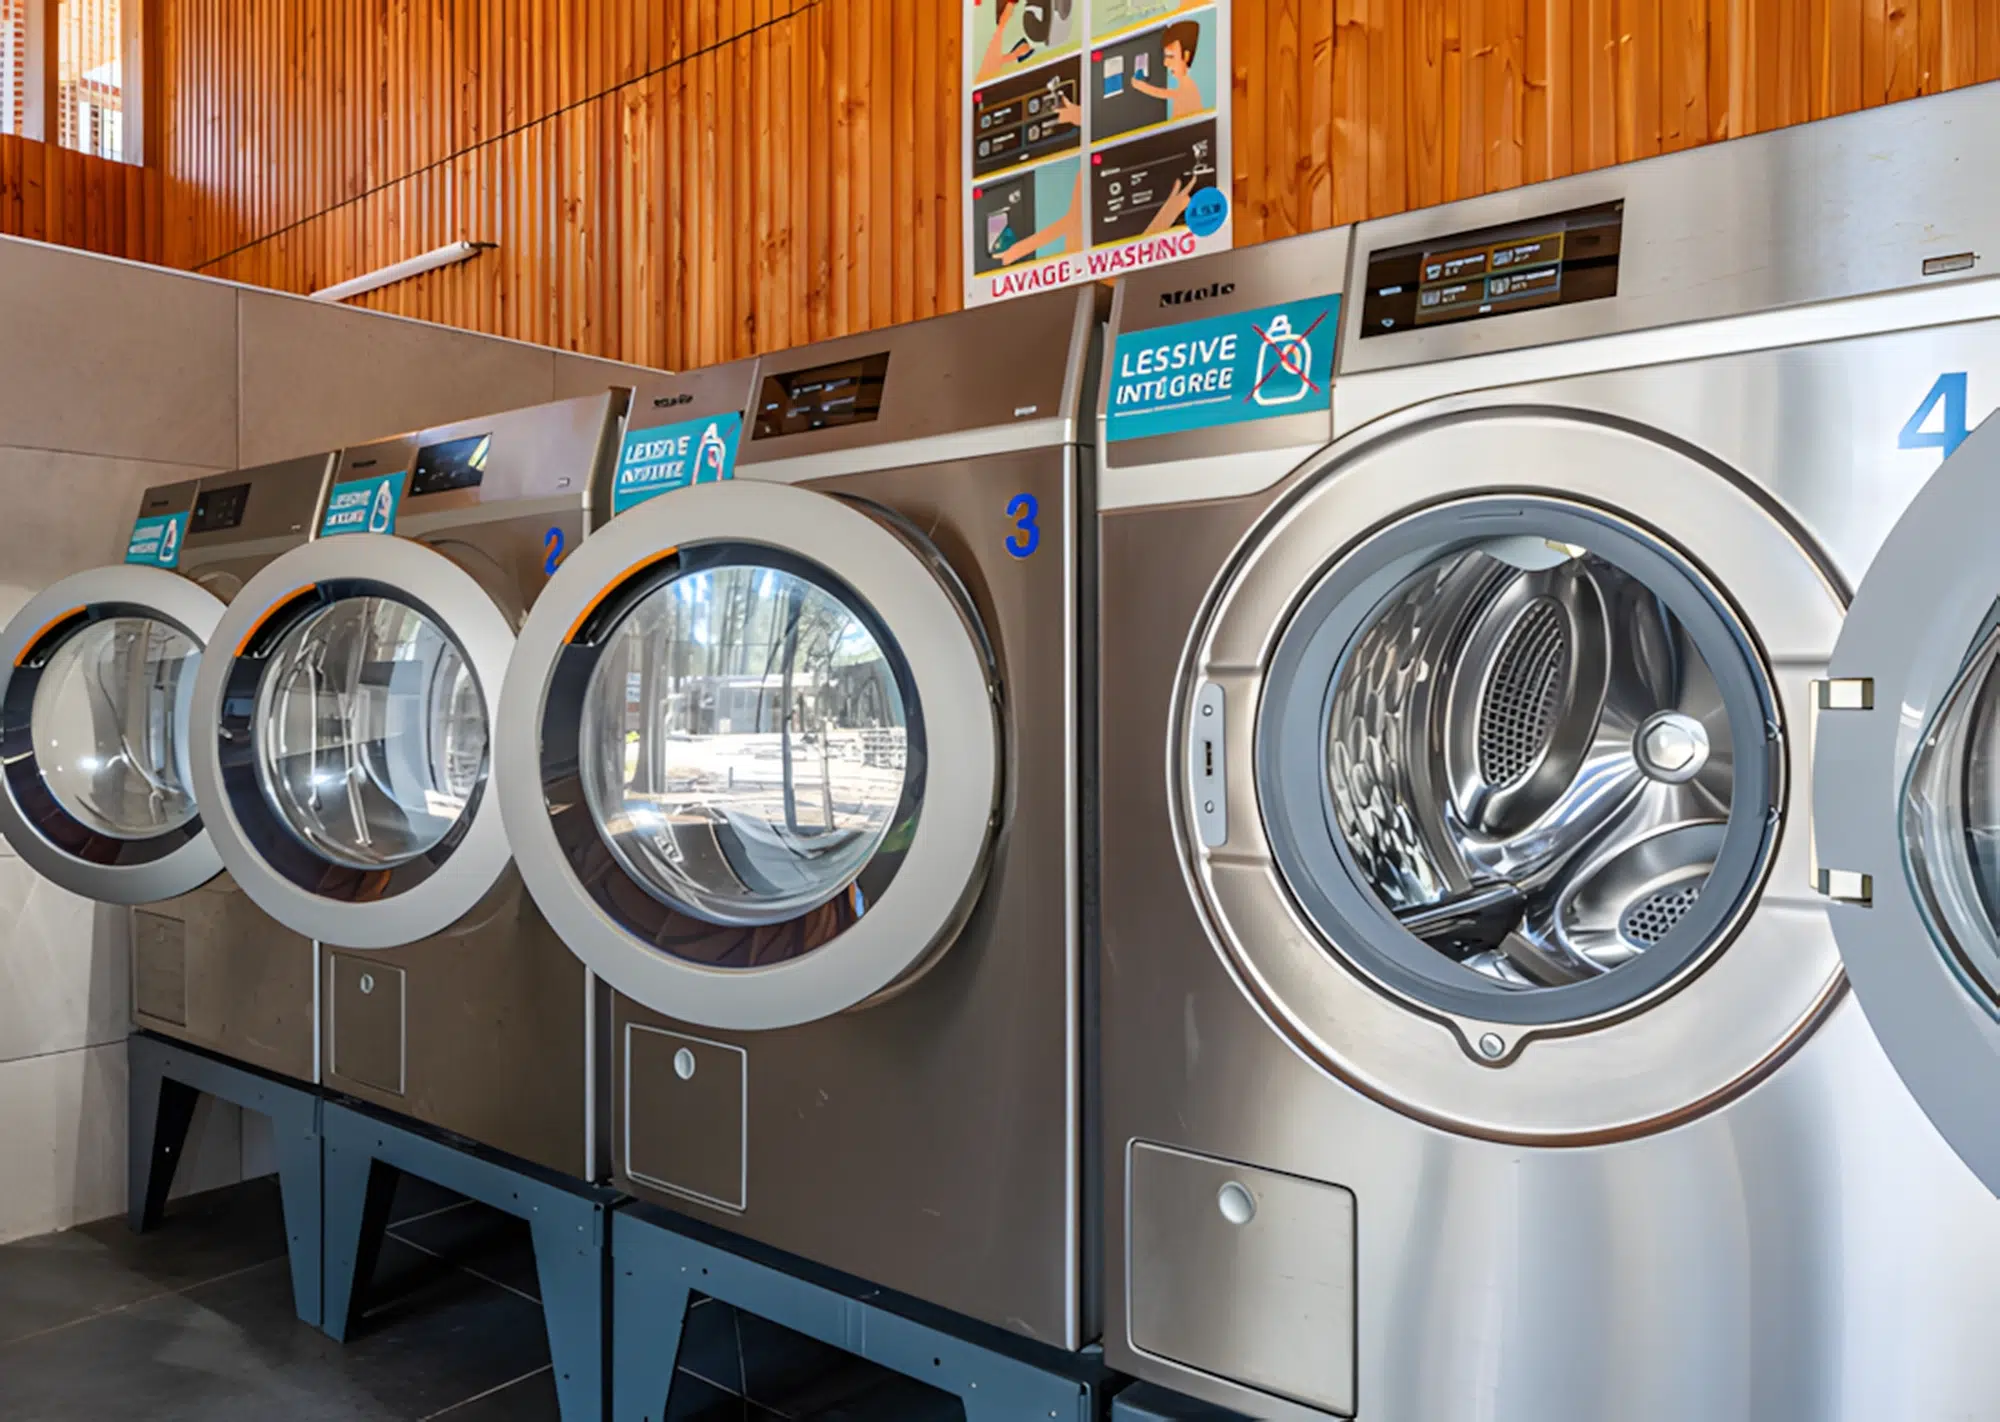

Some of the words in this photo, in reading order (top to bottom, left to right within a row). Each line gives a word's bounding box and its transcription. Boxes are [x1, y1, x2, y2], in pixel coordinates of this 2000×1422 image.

[992, 261, 1070, 297] LAVAGE
[1121, 334, 1237, 377] LESSIVE
[1898, 371, 1972, 461] 4
[1005, 492, 1040, 559] 3
[544, 527, 564, 577] 2
